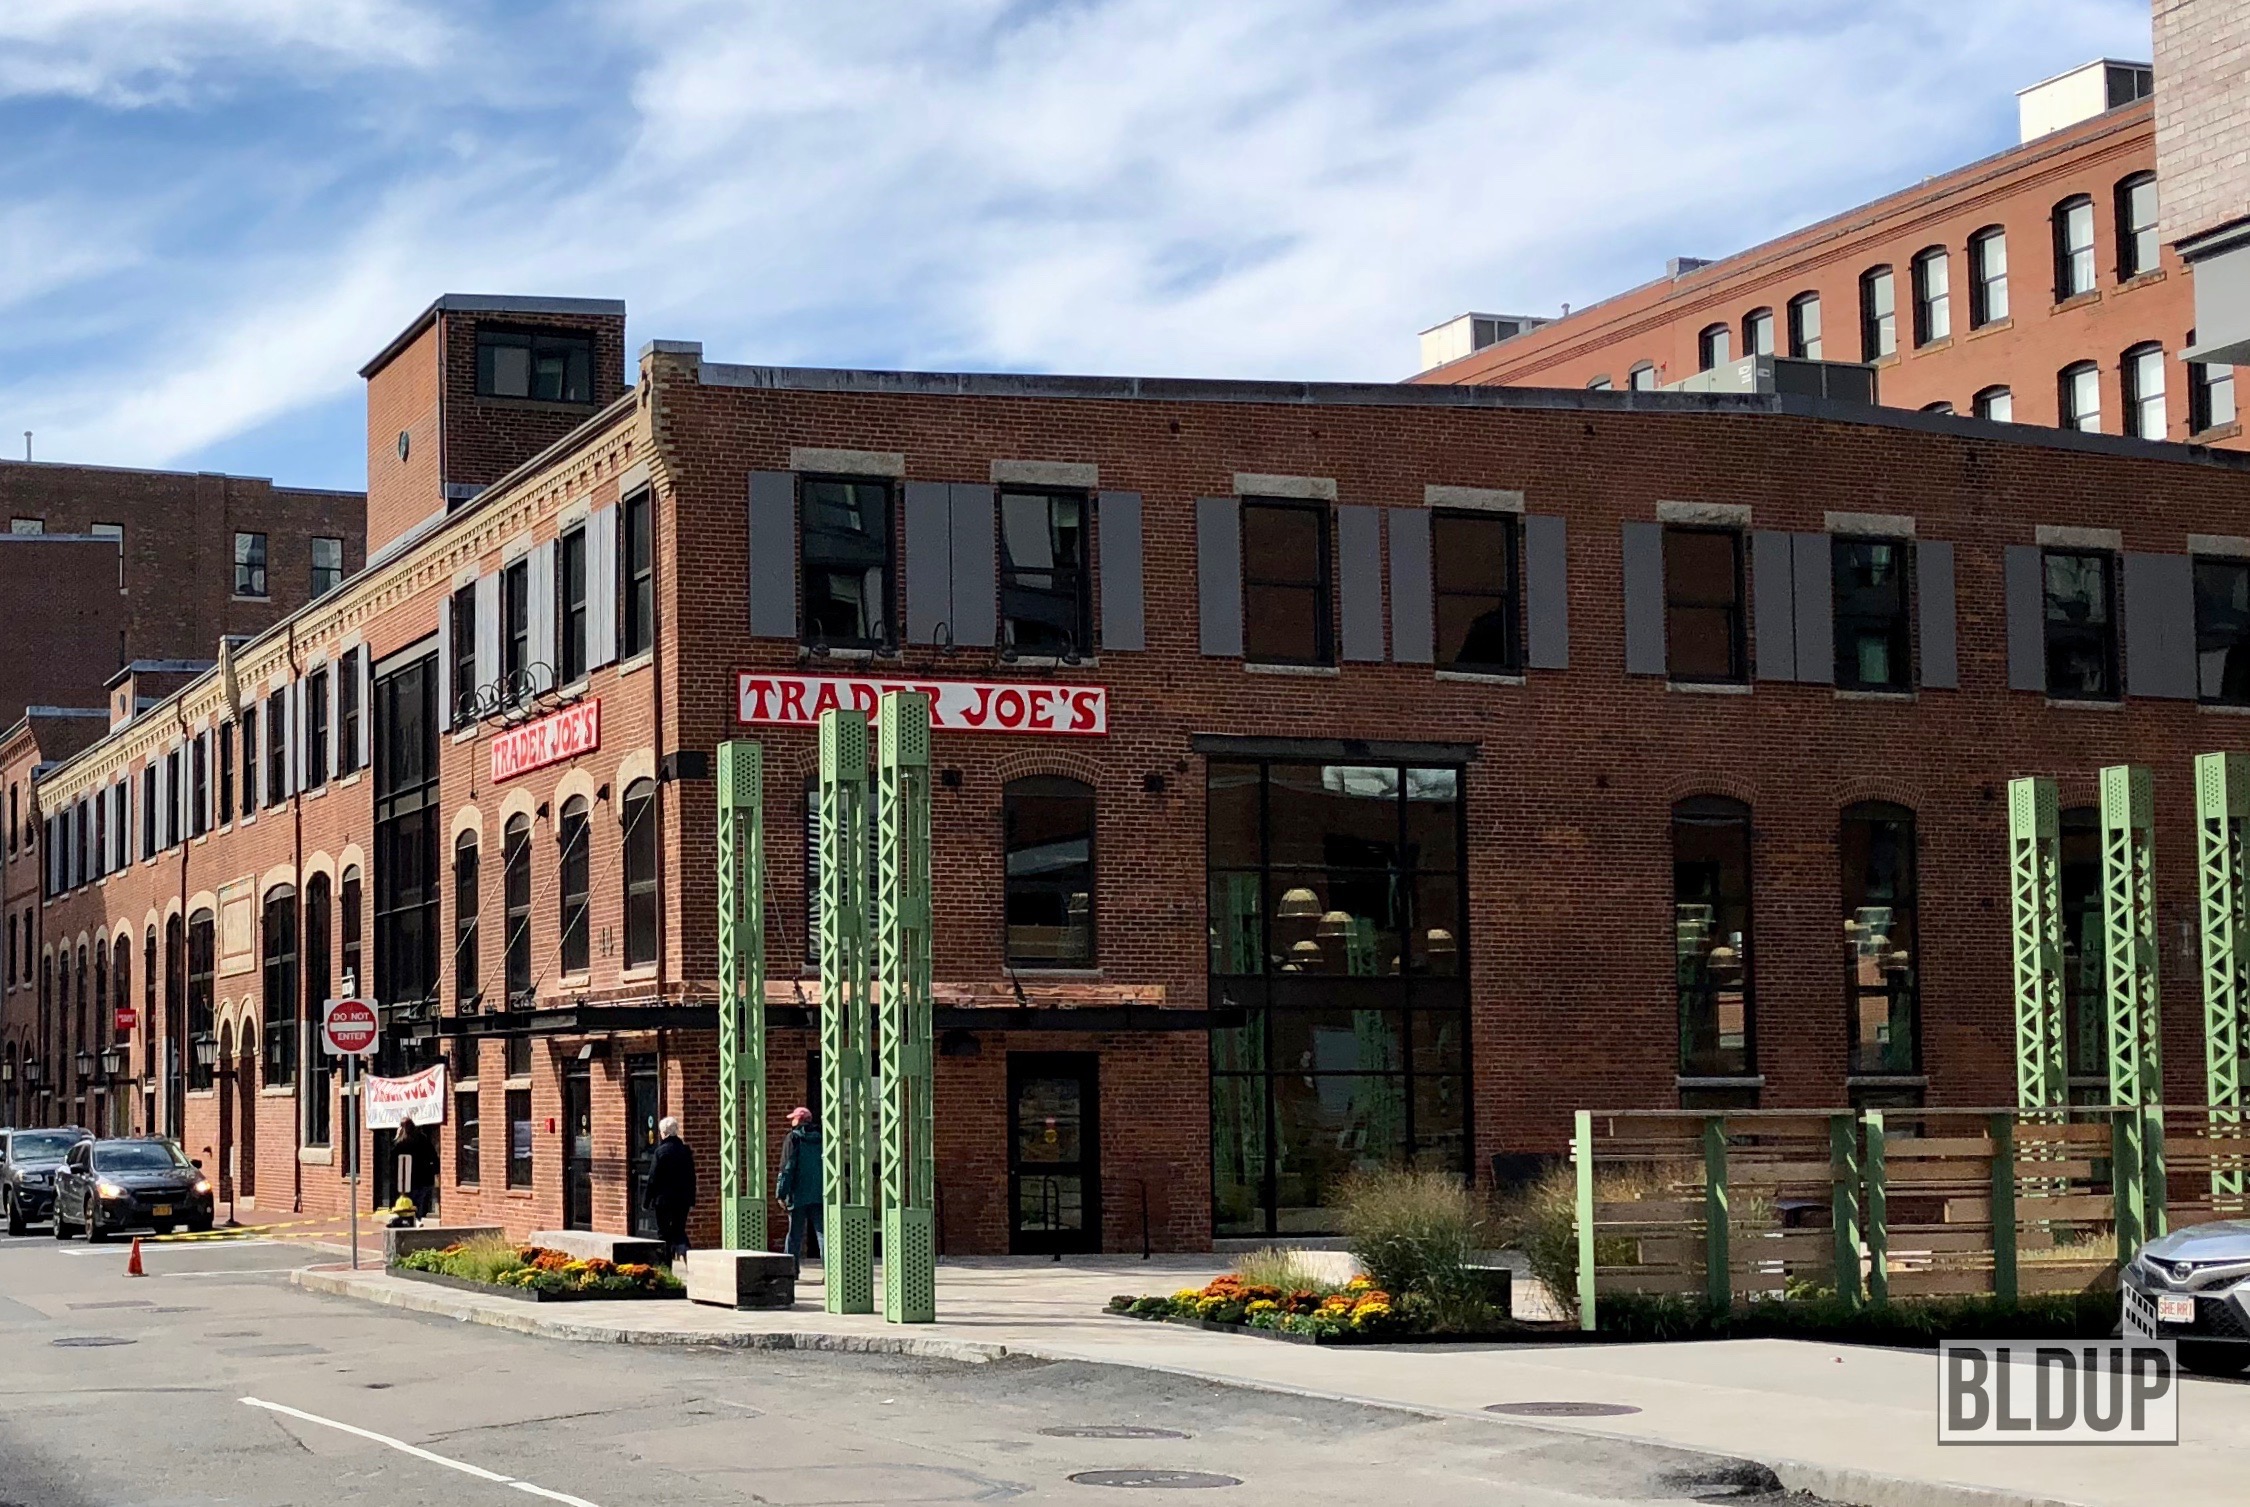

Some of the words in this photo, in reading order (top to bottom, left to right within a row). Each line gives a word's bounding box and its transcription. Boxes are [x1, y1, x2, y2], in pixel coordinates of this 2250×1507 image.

[745, 679, 945, 725] TRADR
[959, 687, 1101, 730] JOE'S
[493, 725, 547, 776] TRADER
[551, 707, 594, 755] JOE'S
[333, 1012, 347, 1021] DO
[351, 1012, 369, 1020] NOT
[337, 1032, 367, 1041] ENTER
